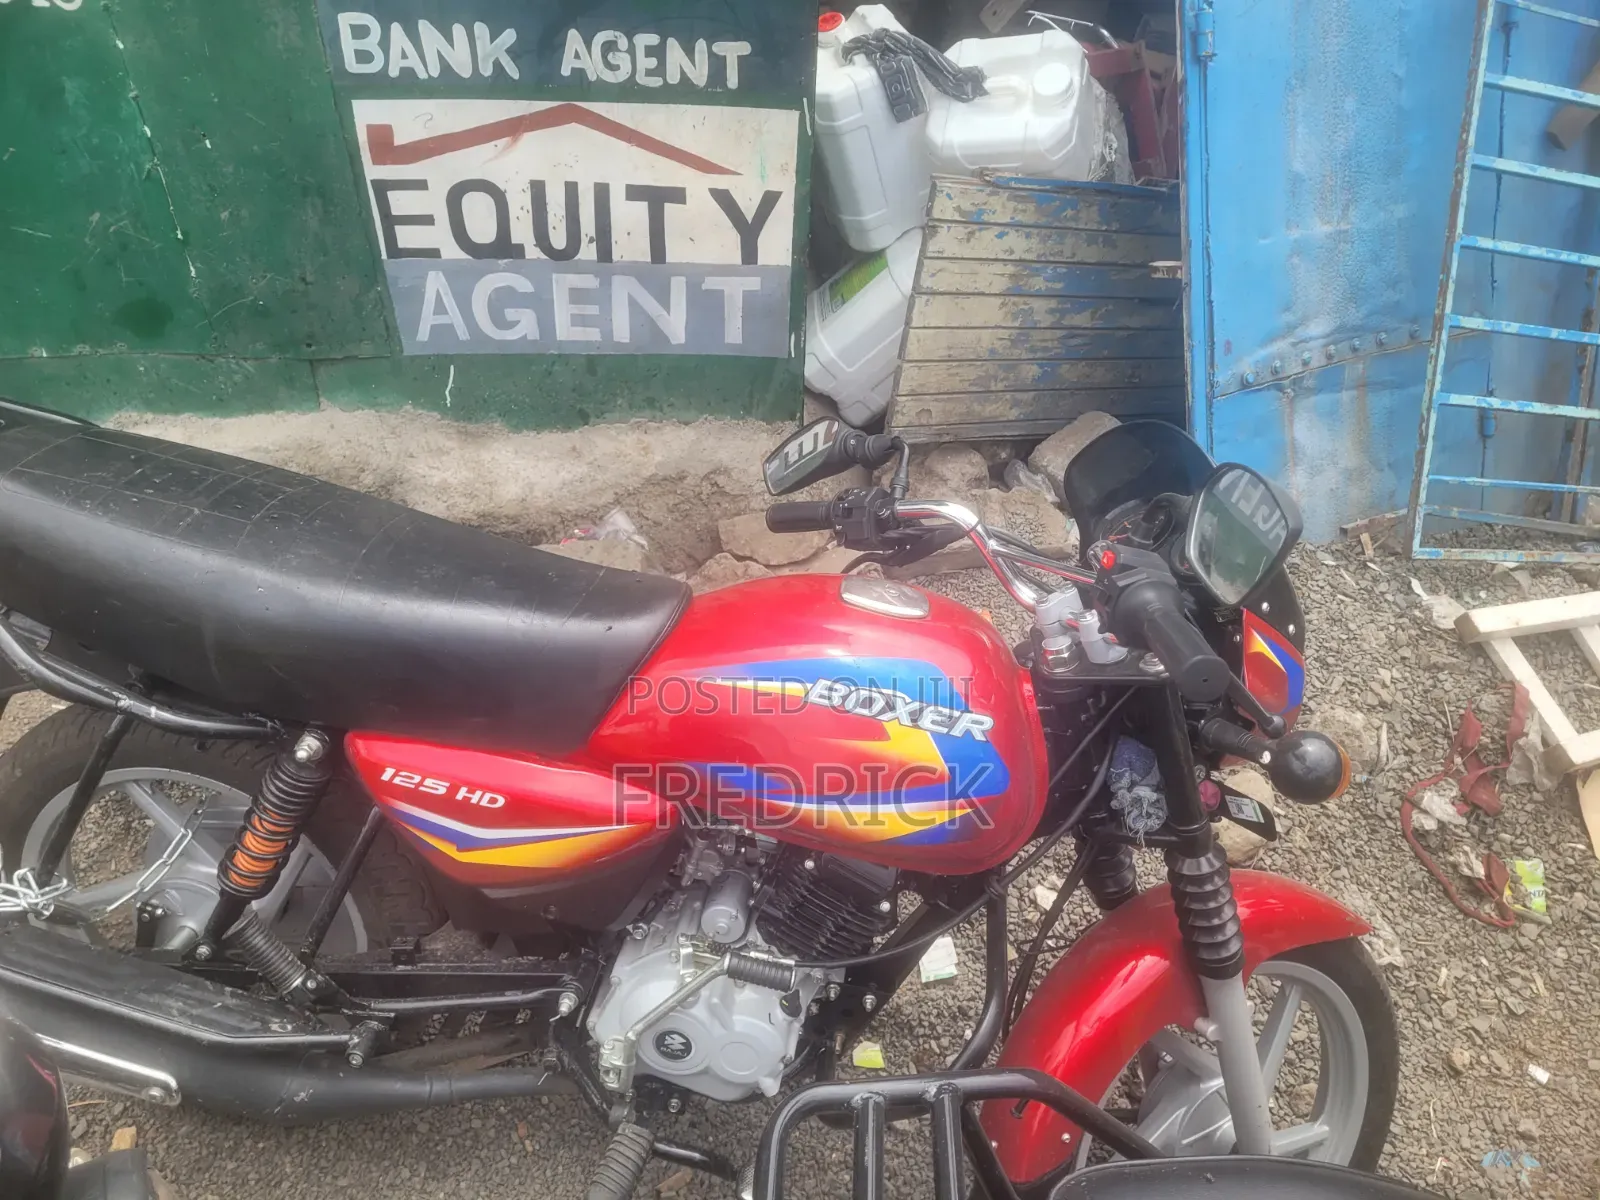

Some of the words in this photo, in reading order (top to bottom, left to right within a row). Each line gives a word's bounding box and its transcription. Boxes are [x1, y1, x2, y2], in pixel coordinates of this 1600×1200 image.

[338, 12, 519, 79] BANK
[561, 28, 751, 89] AGENT
[371, 178, 783, 265] EQUITY
[416, 271, 761, 344] AGENT
[804, 677, 994, 742] BOXER
[380, 767, 450, 795] 125
[455, 786, 505, 808] HD
